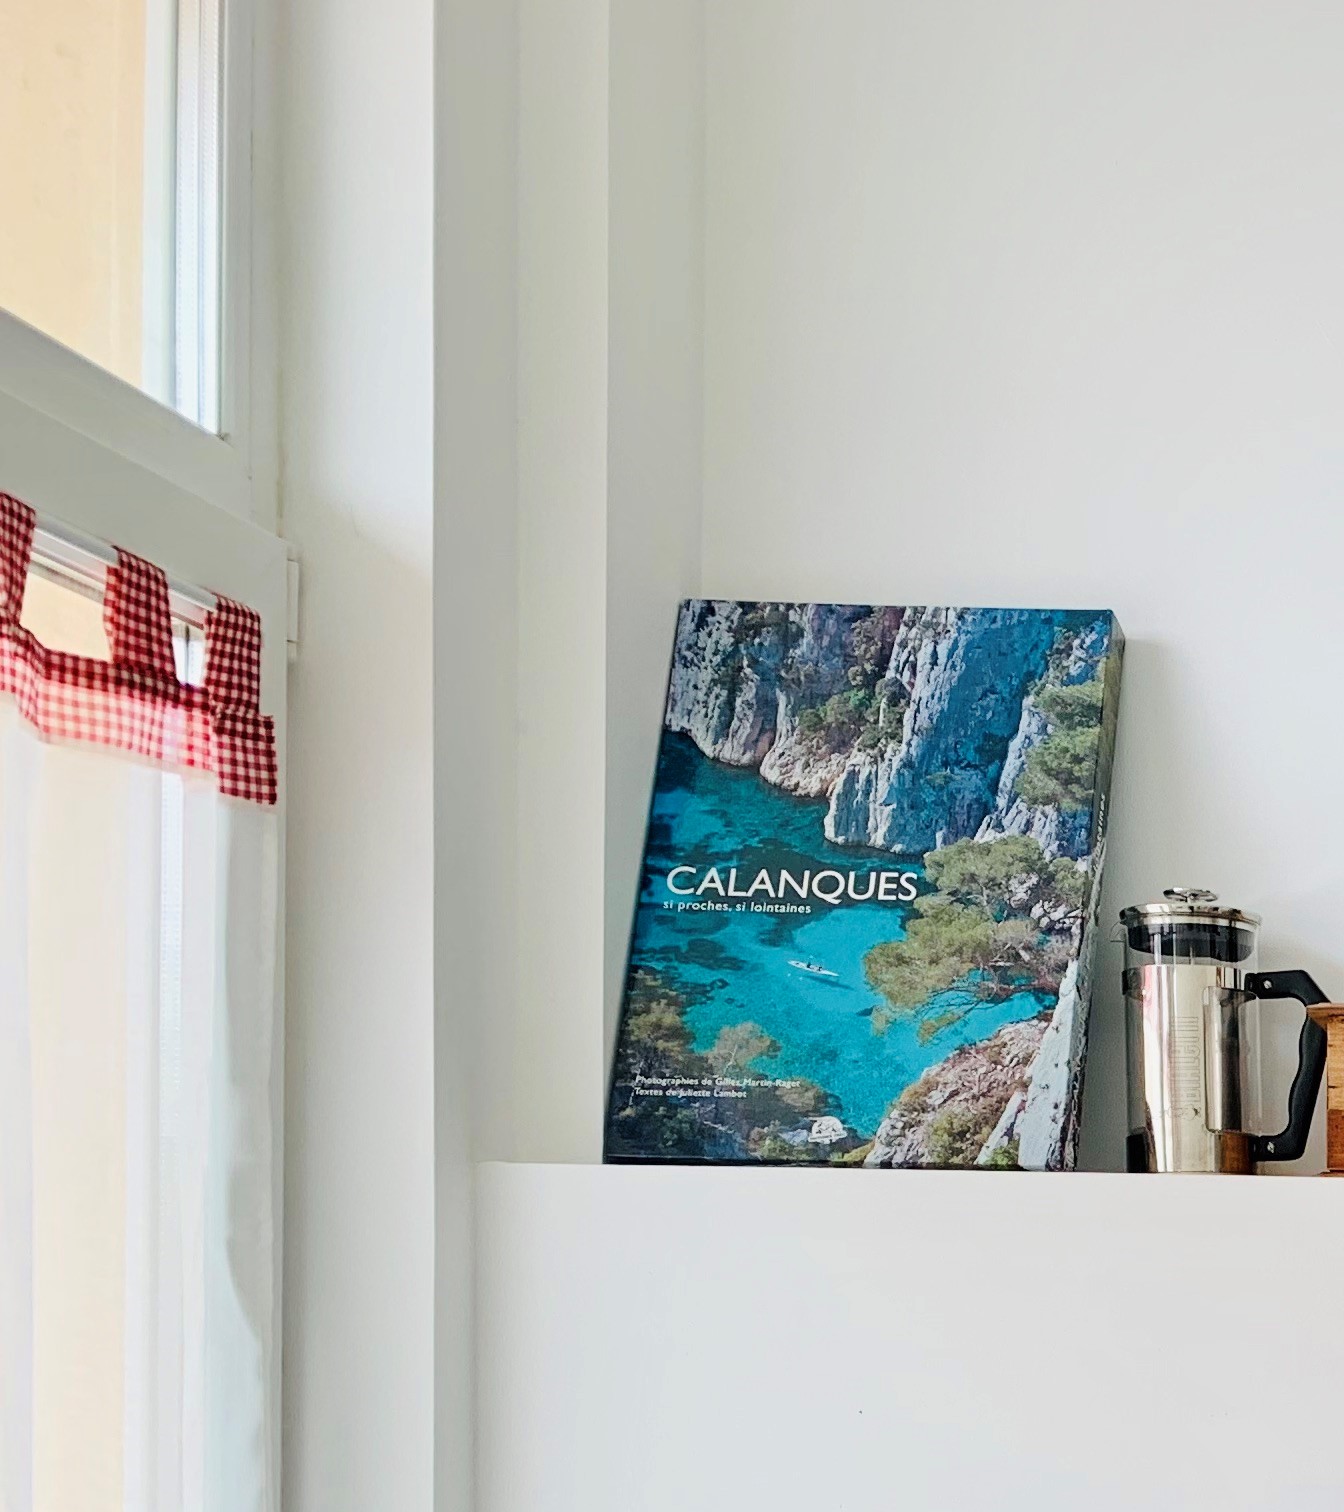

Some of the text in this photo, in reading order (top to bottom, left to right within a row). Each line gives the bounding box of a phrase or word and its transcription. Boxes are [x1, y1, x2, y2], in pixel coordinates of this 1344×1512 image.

[666, 866, 918, 905] CALANQUES
[663, 901, 673, 909] si
[735, 902, 746, 912] si
[750, 902, 811, 914] lointaines
[636, 1075, 699, 1087] Photographies
[701, 1078, 713, 1086] de
[634, 1087, 664, 1096] Textes
